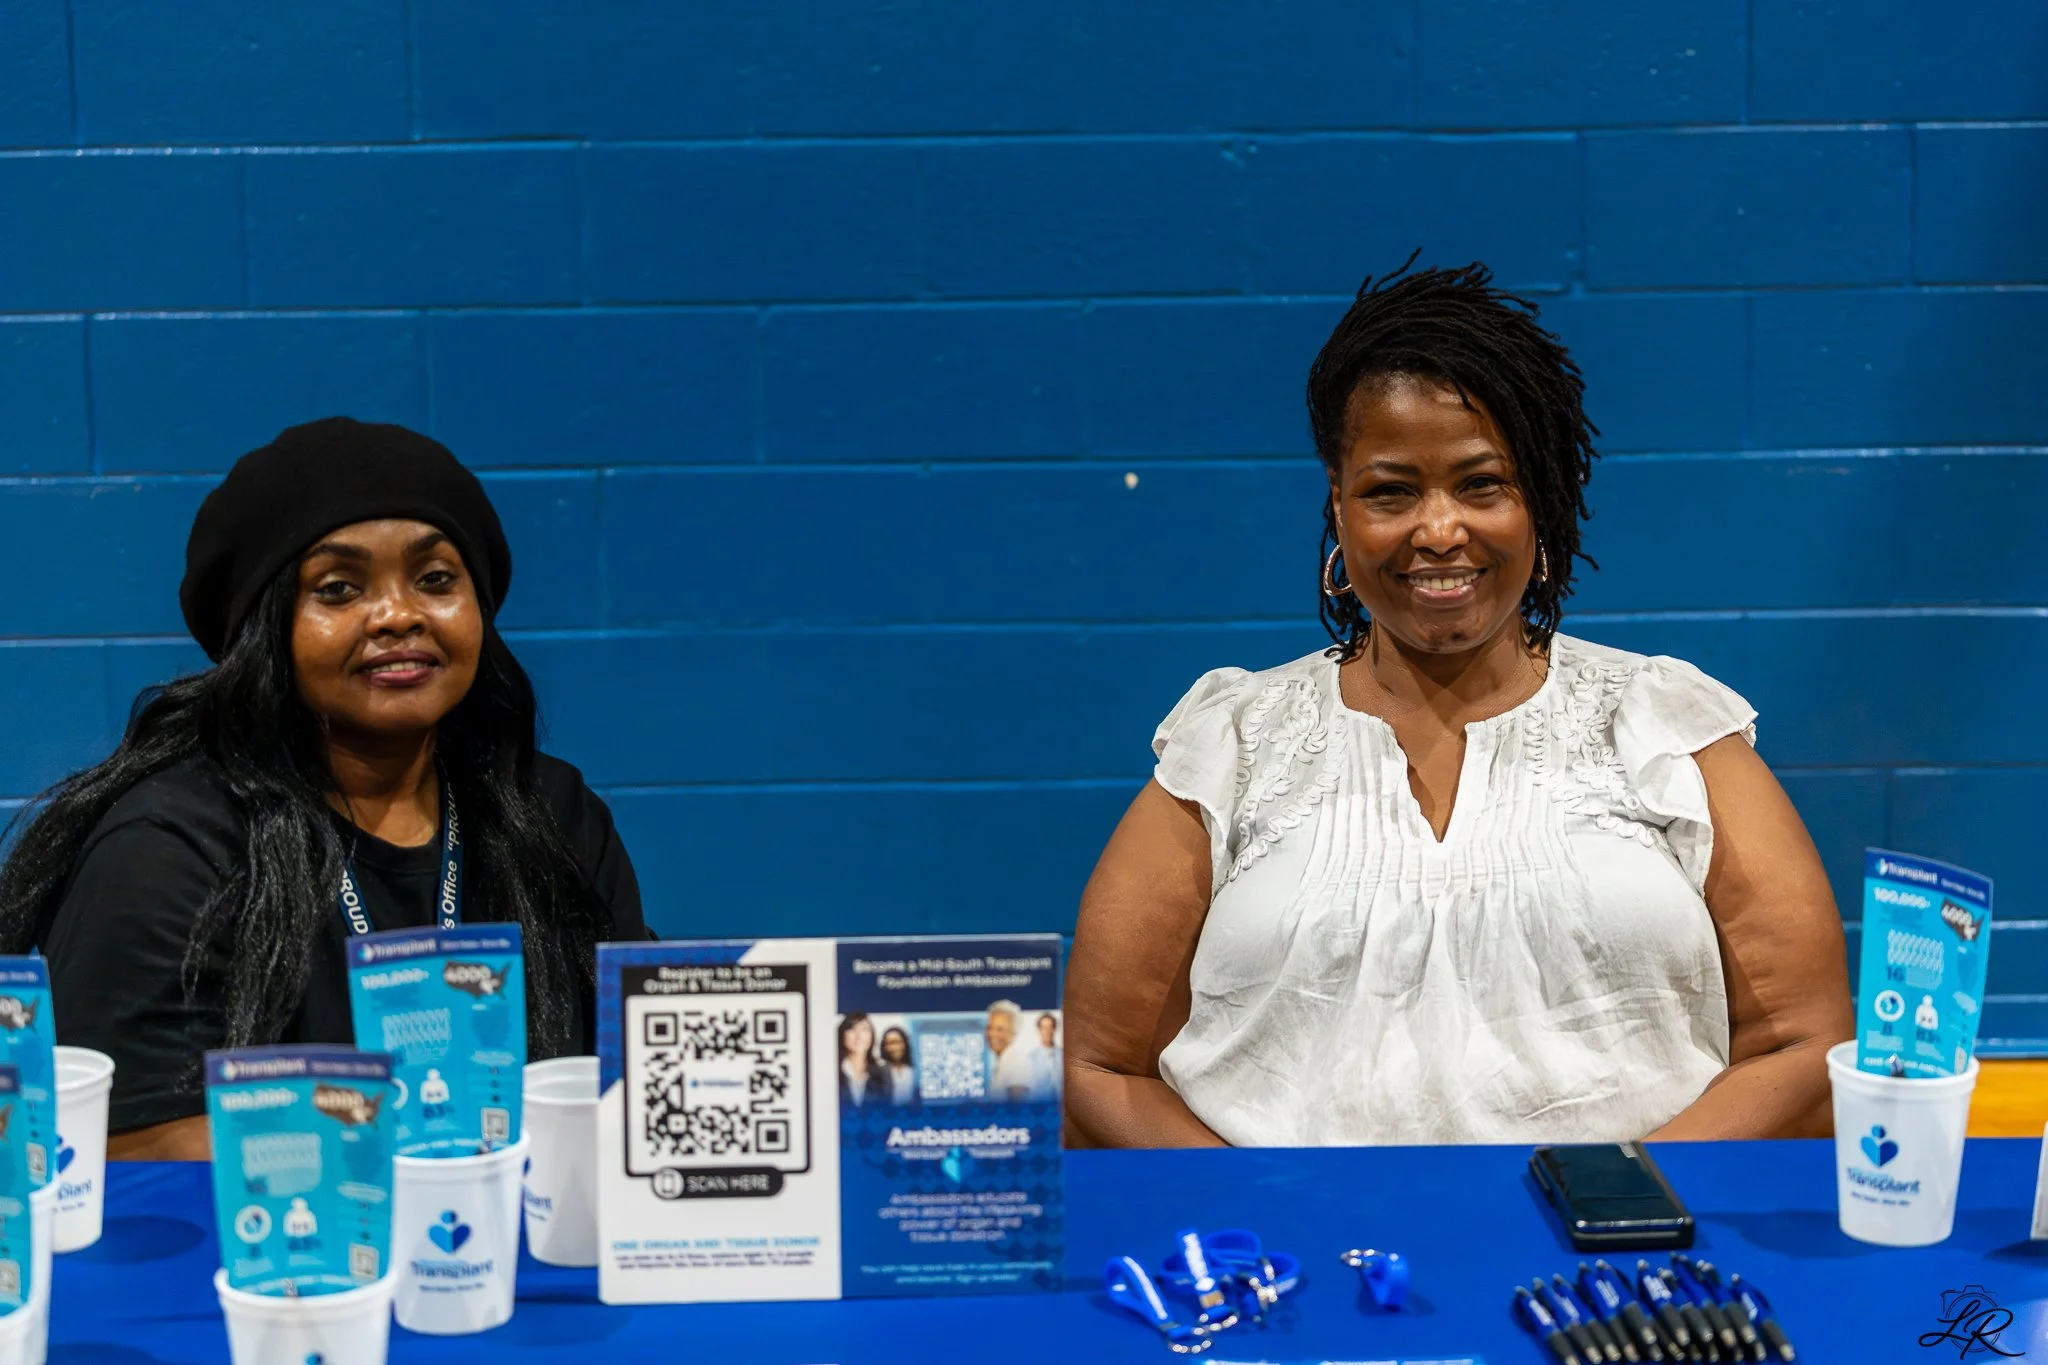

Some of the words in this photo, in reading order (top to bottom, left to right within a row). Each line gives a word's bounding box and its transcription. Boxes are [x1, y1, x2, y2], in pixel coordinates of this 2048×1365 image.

[442, 860, 458, 914] Office
[374, 938, 437, 957] Transplant
[658, 966, 714, 980] Register
[716, 967, 731, 979] to
[733, 966, 751, 979] be
[754, 967, 772, 978] an
[853, 959, 905, 973] Become
[985, 956, 1052, 971] Transplant
[643, 979, 686, 994] Organ
[701, 977, 743, 992] Tissue
[744, 977, 787, 991] Donor
[877, 974, 950, 989] Foundation
[953, 973, 1031, 987] Ambassador
[886, 1124, 1031, 1146] Ambassadors
[686, 1175, 729, 1193] SCAN
[730, 1174, 770, 1191] HERE
[889, 1193, 973, 1205] Ambassadors
[921, 1206, 958, 1217] about
[941, 1218, 957, 1230] of
[959, 1218, 995, 1231] organ
[997, 1217, 1022, 1229] and
[409, 1260, 494, 1279] Transplant
